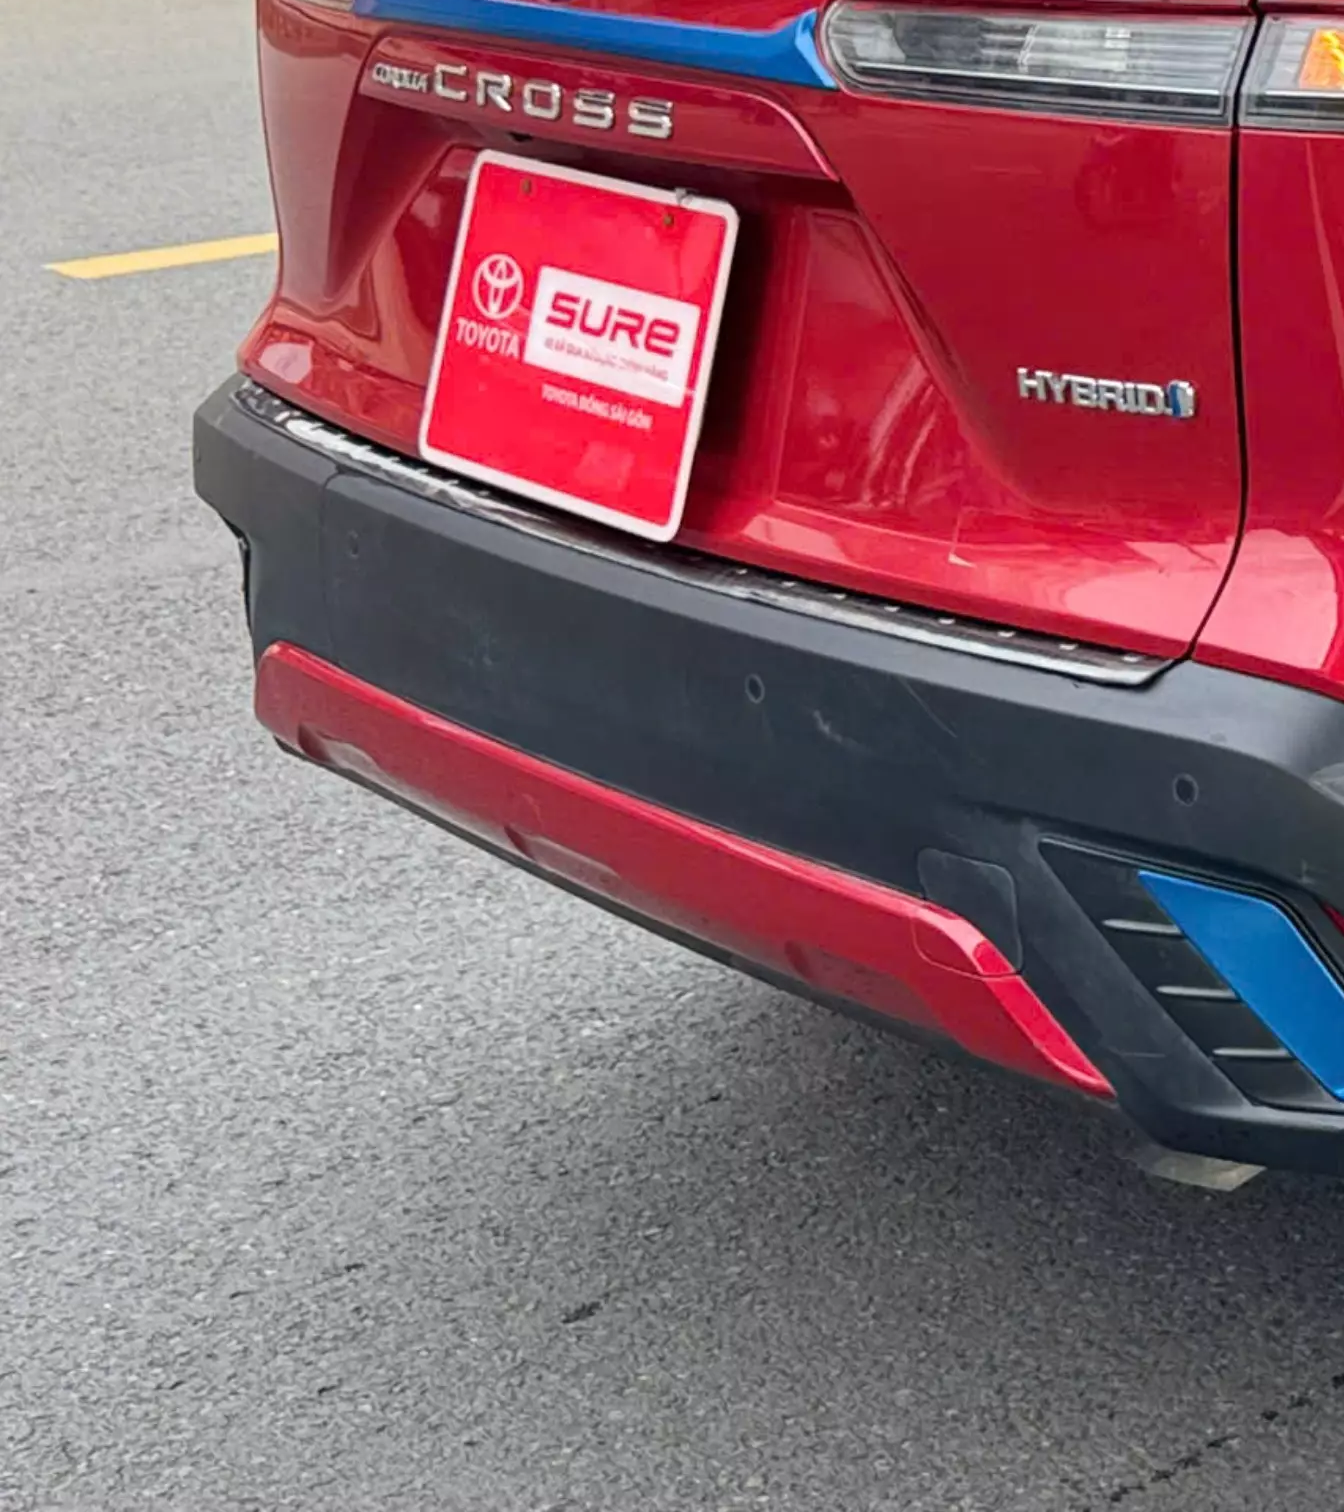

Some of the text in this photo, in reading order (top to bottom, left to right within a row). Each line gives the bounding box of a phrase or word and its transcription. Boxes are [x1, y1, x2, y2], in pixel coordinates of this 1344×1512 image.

[433, 63, 674, 139] CROSS
[456, 317, 520, 359] TOYOTA
[1016, 367, 1164, 416] HYBRID
